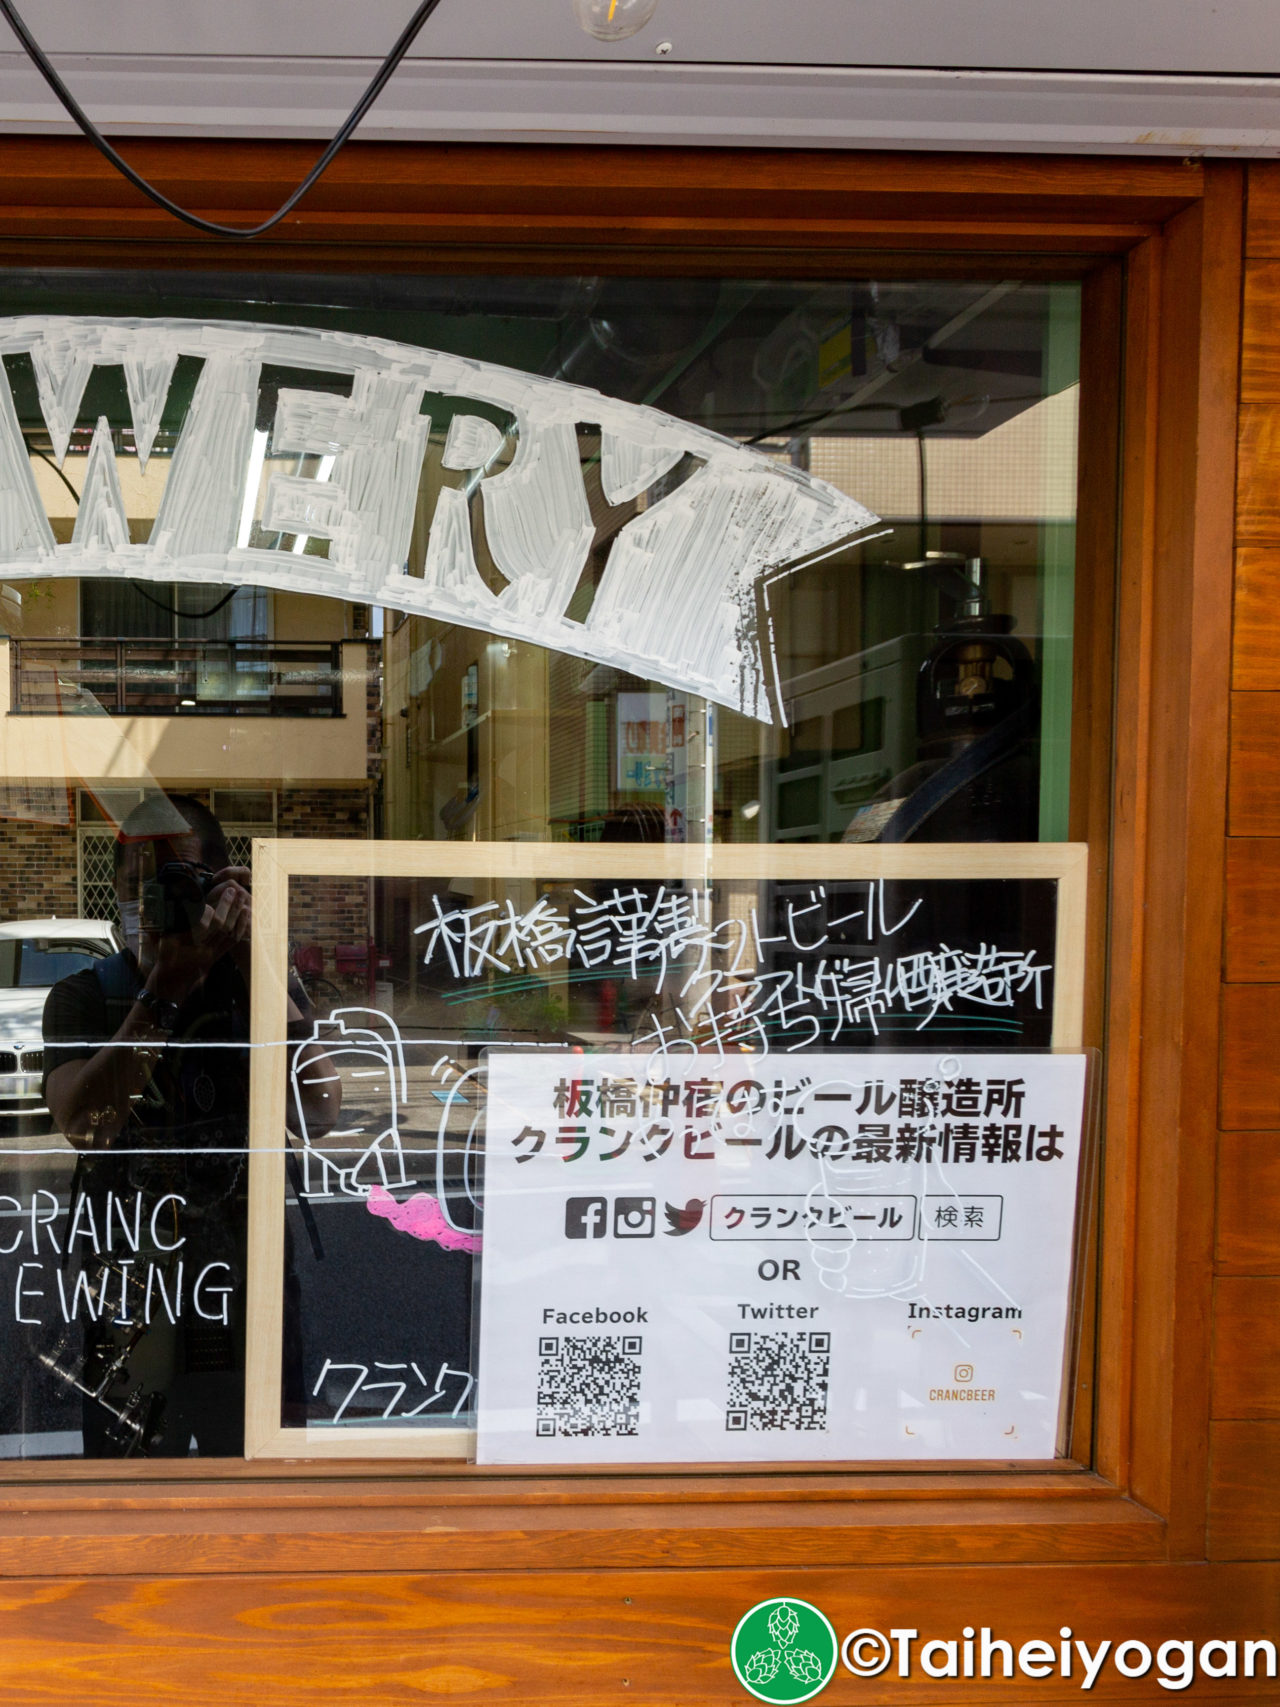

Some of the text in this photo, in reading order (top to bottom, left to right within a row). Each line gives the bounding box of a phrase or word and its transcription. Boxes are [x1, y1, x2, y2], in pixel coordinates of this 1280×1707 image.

[552, 1077, 1026, 1119] 板橋仲宿のビール醸造所
[510, 1123, 1065, 1164] クランクビールの最新情報は
[723, 1205, 984, 1230] クランクビール 検索
[756, 1258, 802, 1282] OR
[542, 1302, 1023, 1326] Facebook Twitter Instagram
[312, 1358, 474, 1424] クランク
[928, 1388, 997, 1402] CRANCBEER
